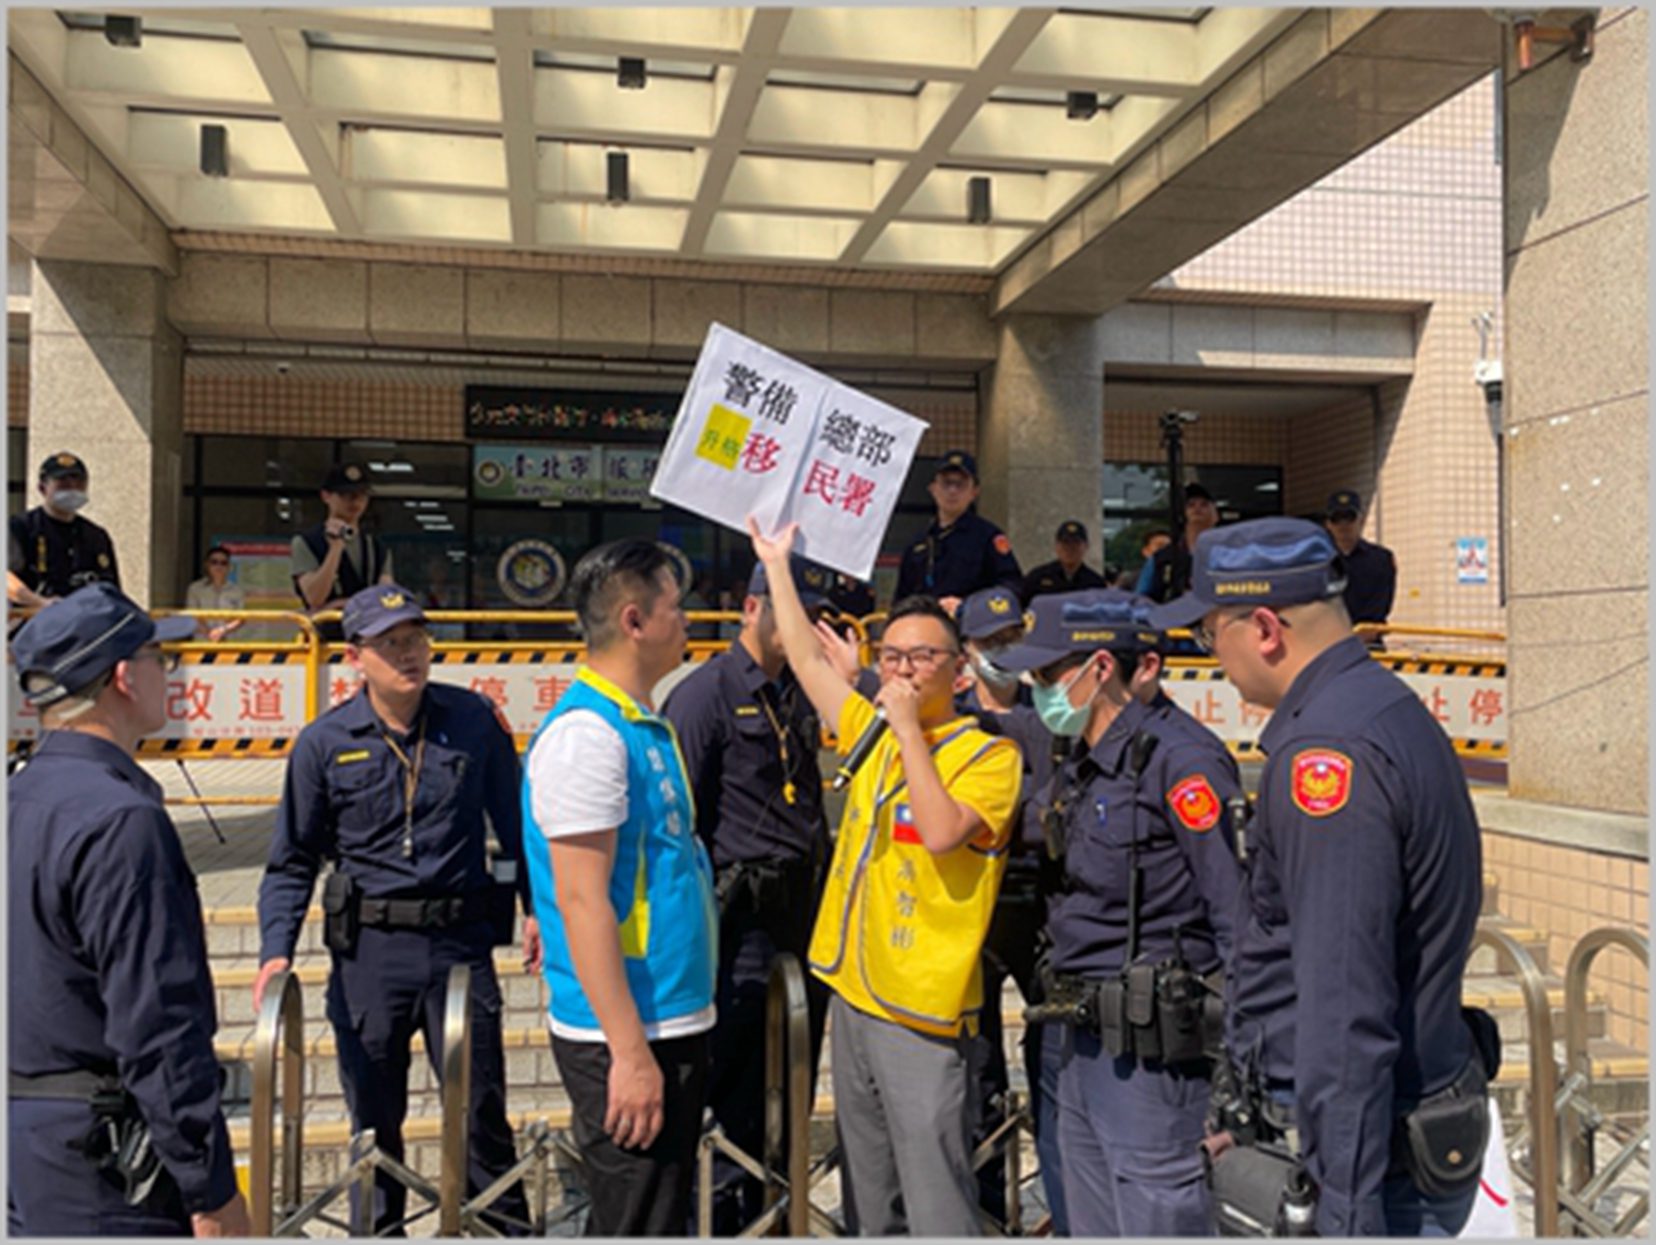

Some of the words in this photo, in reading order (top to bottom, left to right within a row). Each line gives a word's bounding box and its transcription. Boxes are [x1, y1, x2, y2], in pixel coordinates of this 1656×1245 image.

[723, 361, 797, 425] 警備
[820, 409, 895, 467] 總部
[741, 432, 782, 475] 移
[803, 460, 876, 517] 民署
